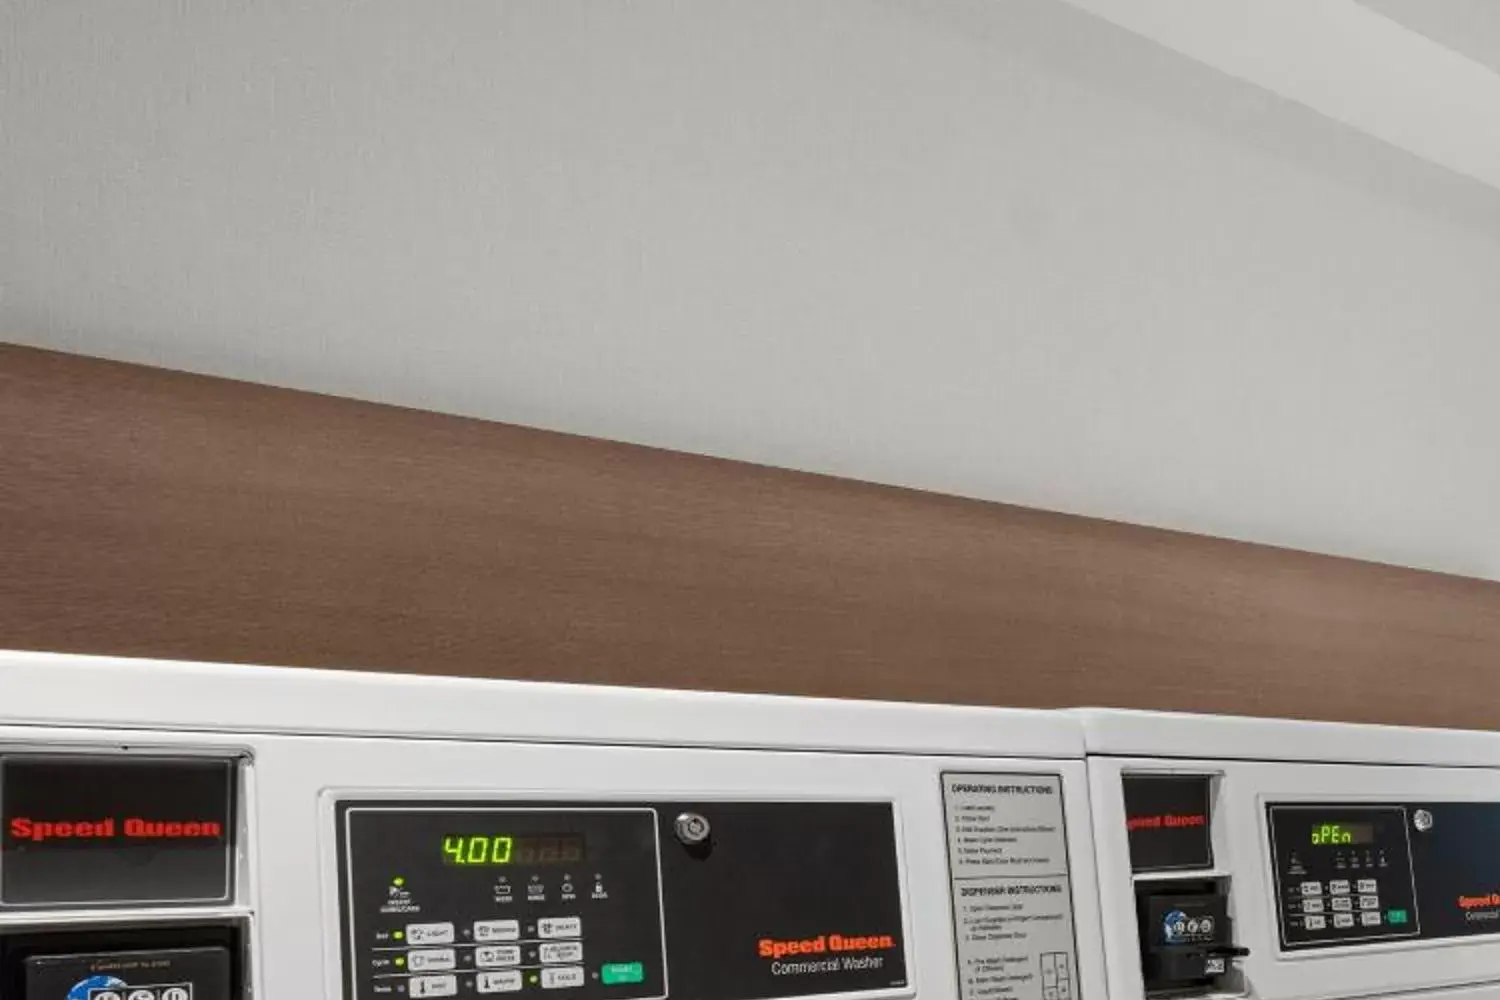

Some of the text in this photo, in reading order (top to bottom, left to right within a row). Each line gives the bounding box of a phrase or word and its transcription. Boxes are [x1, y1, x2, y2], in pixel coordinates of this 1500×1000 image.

[10, 816, 221, 841] Speed Queen
[444, 836, 512, 864] 4.00
[757, 933, 892, 959] Speed Queen
[770, 956, 884, 976] Commercial Washer
